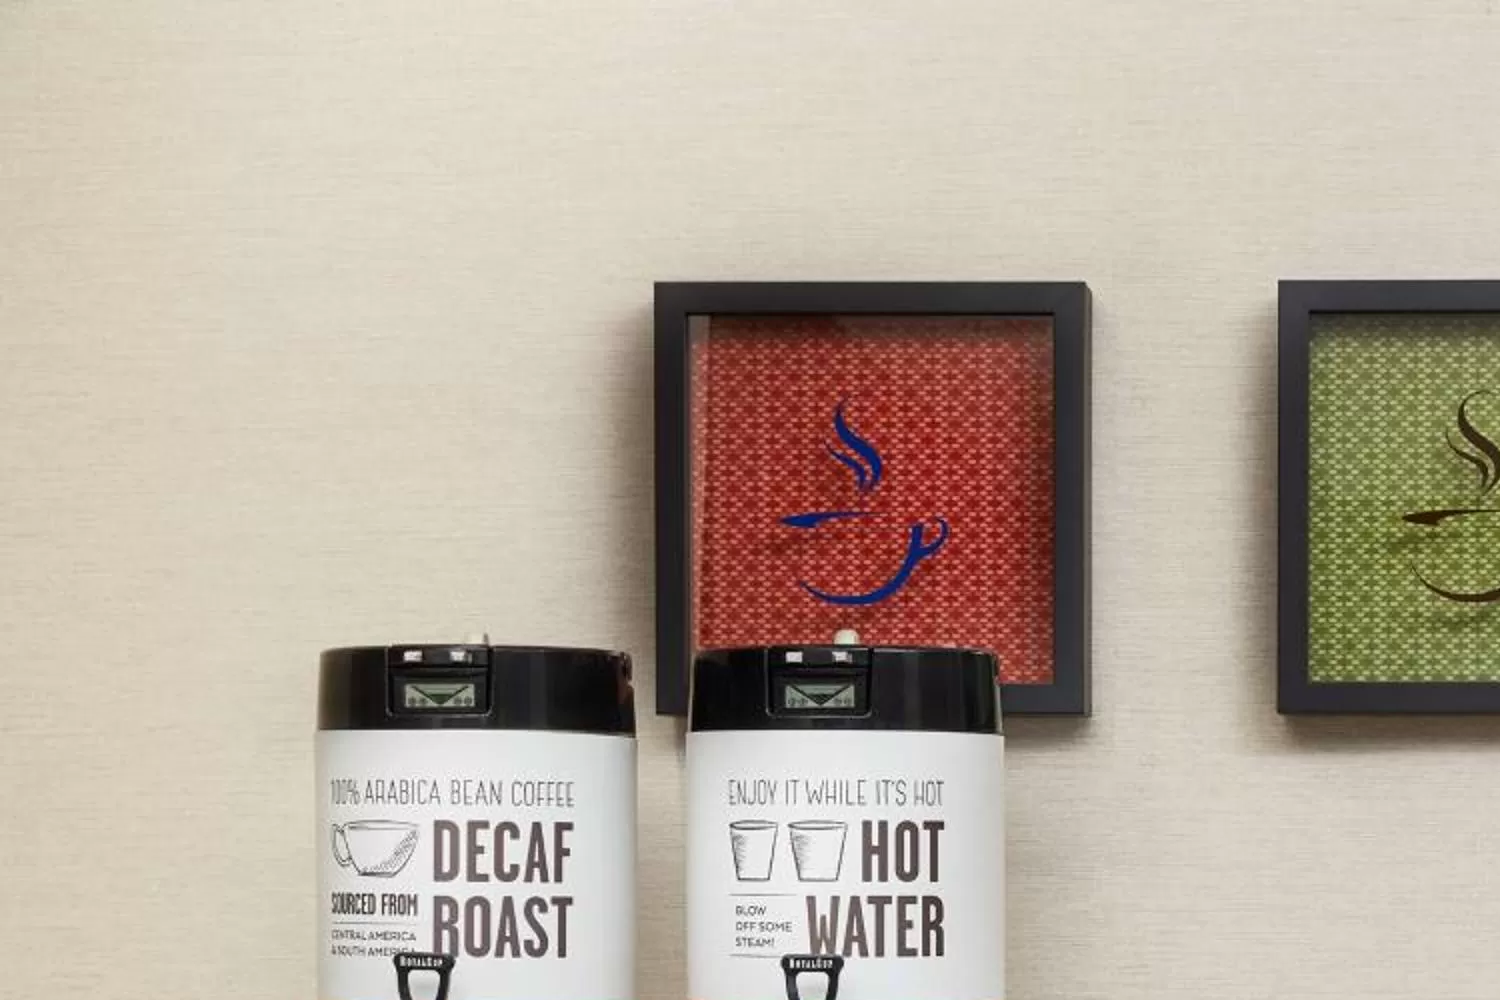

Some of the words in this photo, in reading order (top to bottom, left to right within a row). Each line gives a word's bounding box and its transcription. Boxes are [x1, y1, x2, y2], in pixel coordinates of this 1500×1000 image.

[365, 779, 441, 805] ARABICA
[451, 779, 502, 806] BEAN
[511, 780, 575, 807] COFFEE
[728, 779, 777, 806] ENJOY
[785, 780, 800, 806] IT
[805, 780, 867, 806] WHILE
[876, 780, 907, 807] IT'S
[913, 781, 944, 807] HOT
[434, 820, 574, 883] DECAF
[861, 820, 945, 882] HOT
[331, 892, 377, 915] SOURCED
[381, 893, 418, 916] FROM
[735, 905, 766, 916] BLOW
[368, 931, 417, 941] AMERICA
[433, 895, 573, 958] ROAST
[735, 921, 754, 932] OFF
[758, 921, 792, 932] SOME
[806, 895, 945, 958] WATER
